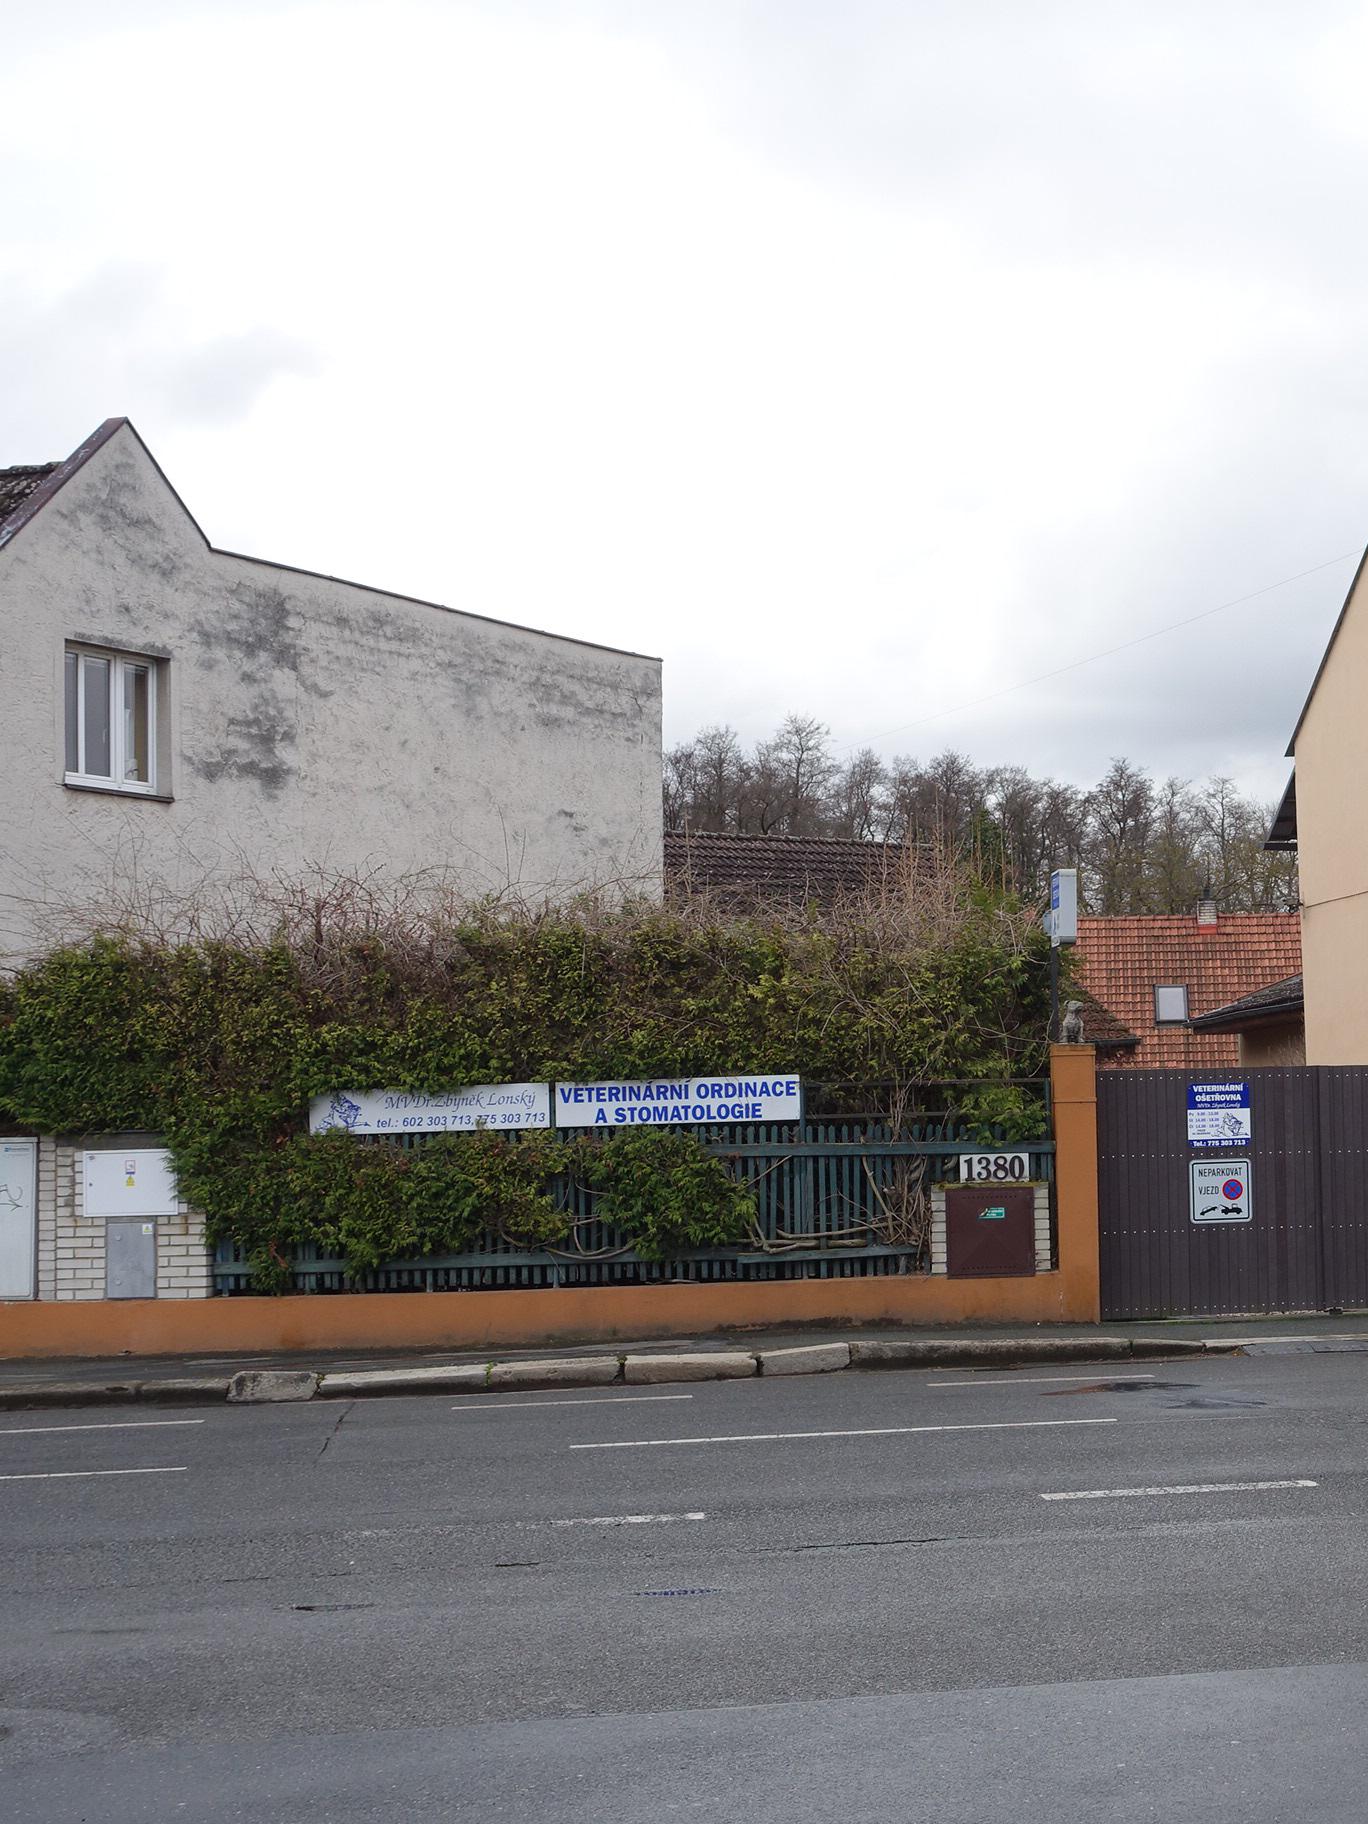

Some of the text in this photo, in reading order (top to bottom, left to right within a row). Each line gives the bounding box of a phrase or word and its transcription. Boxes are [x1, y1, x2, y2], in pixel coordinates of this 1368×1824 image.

[560, 1079, 797, 1104] VETERINÁRNÍ ORDINACE
[1192, 1083, 1244, 1093] VETERINÁRNÍ
[486, 1090, 537, 1110] Lonský
[1195, 1093, 1242, 1102] OŠETŘOVNA
[377, 1118, 399, 1128] tel.:
[402, 1117, 423, 1127] 602
[427, 1116, 448, 1126] 303
[500, 1113, 520, 1124] 303
[525, 1112, 545, 1123] 713
[594, 1102, 763, 1124] A STOMATOLOGIE
[963, 1155, 1025, 1181] 1380
[1198, 1166, 1242, 1177] NEPARKOVAT
[1198, 1186, 1220, 1195] VJEZD
